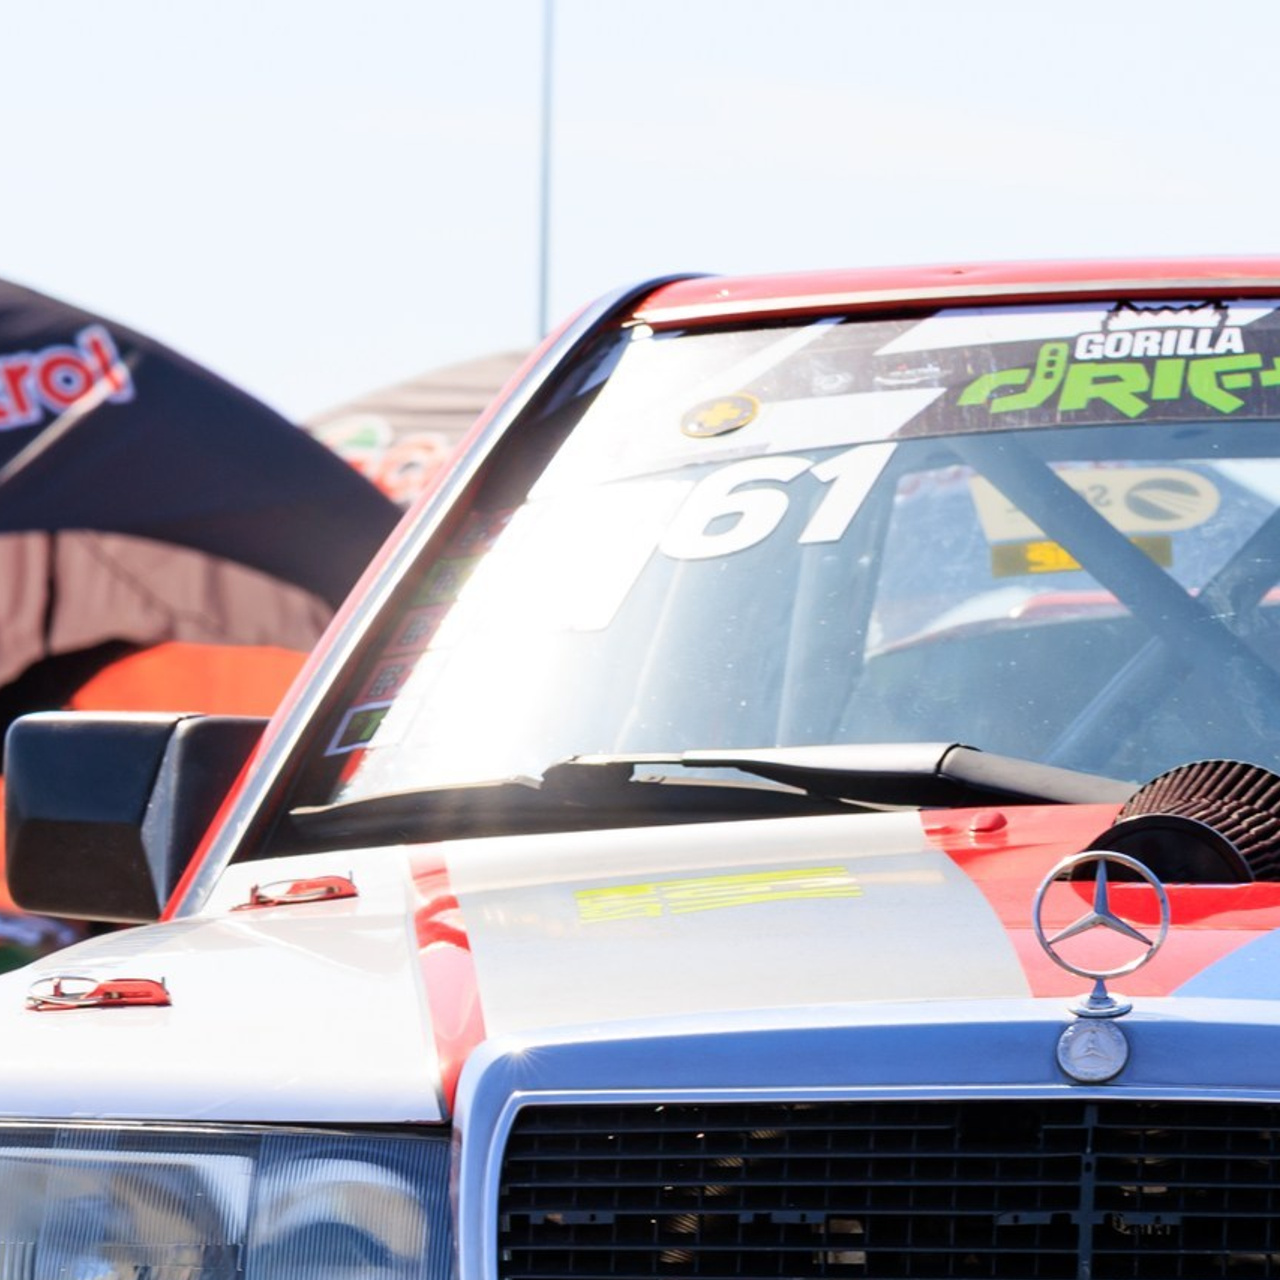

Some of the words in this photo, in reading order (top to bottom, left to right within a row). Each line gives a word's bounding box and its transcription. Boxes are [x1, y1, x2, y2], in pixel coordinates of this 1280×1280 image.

[0, 330, 130, 426] rol
[1075, 325, 1245, 361] GORILLA
[659, 441, 899, 562] 61
